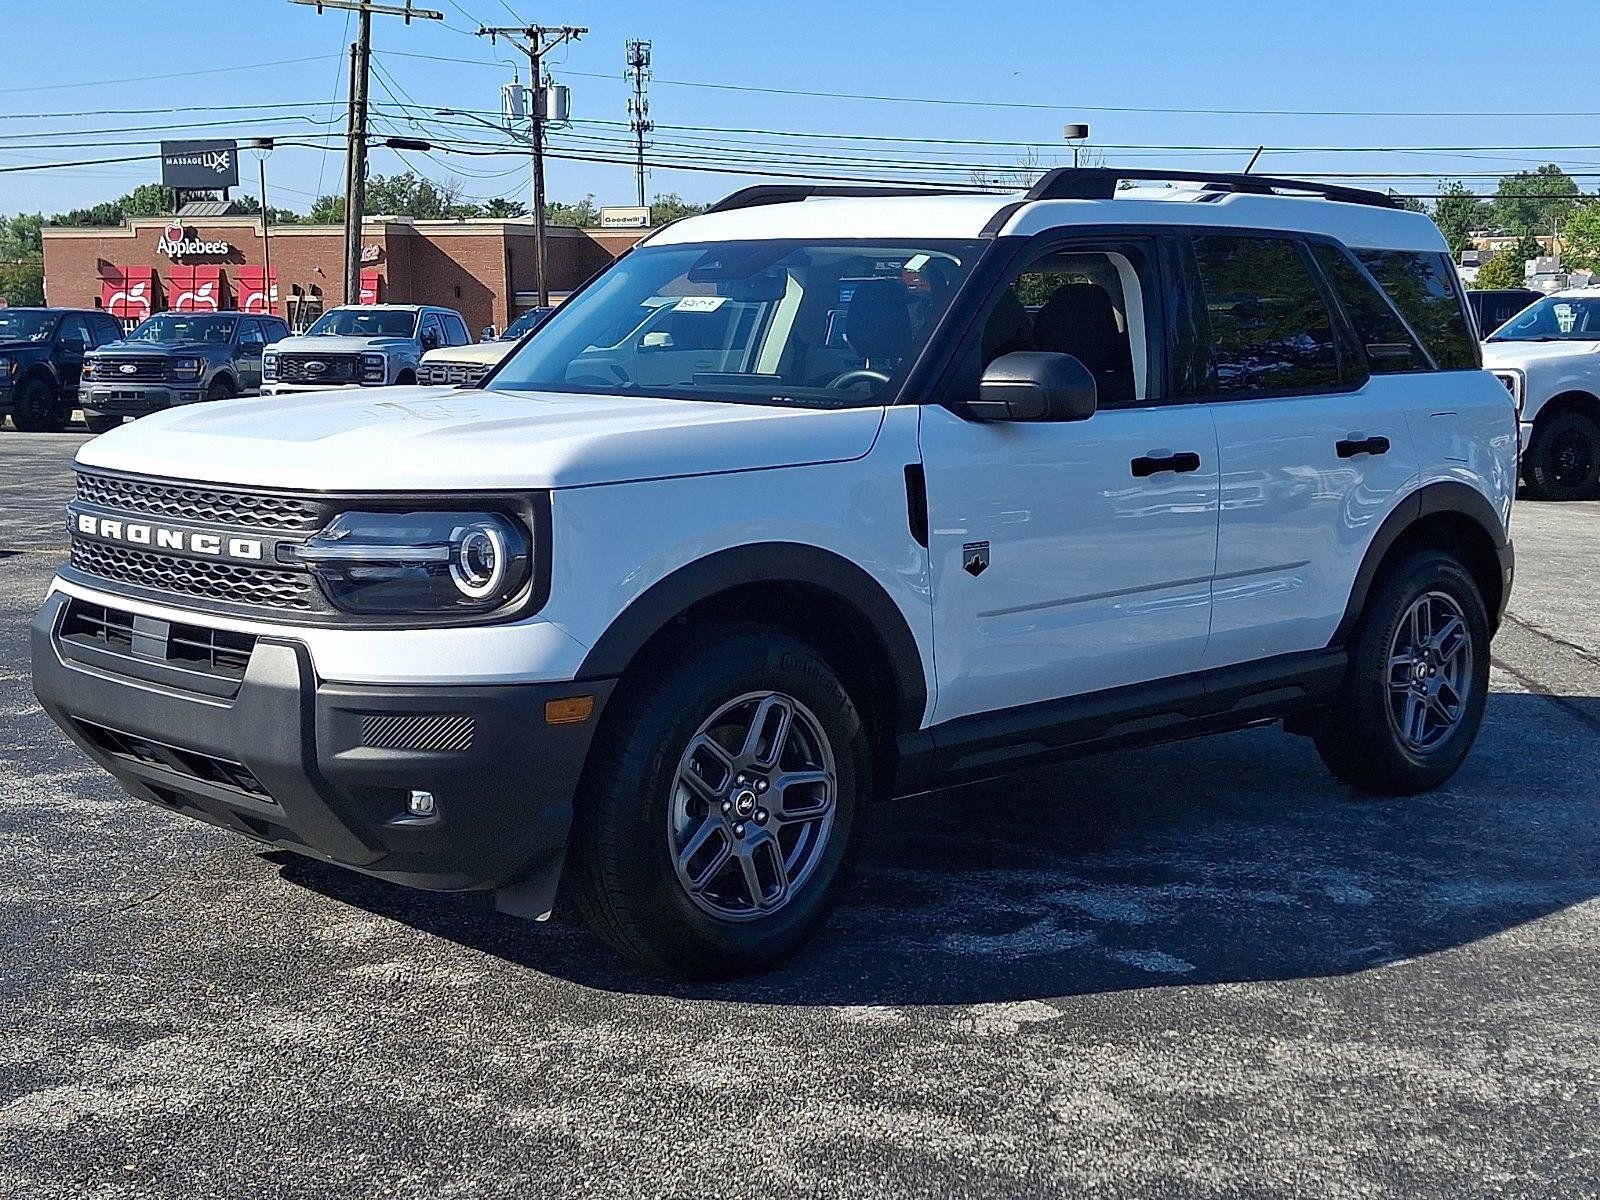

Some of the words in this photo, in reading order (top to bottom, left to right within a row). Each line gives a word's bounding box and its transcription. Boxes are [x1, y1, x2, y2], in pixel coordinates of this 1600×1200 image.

[165, 157, 202, 165] MASSAGE
[156, 235, 229, 258] Applebee's
[78, 514, 262, 560] BRONCO
